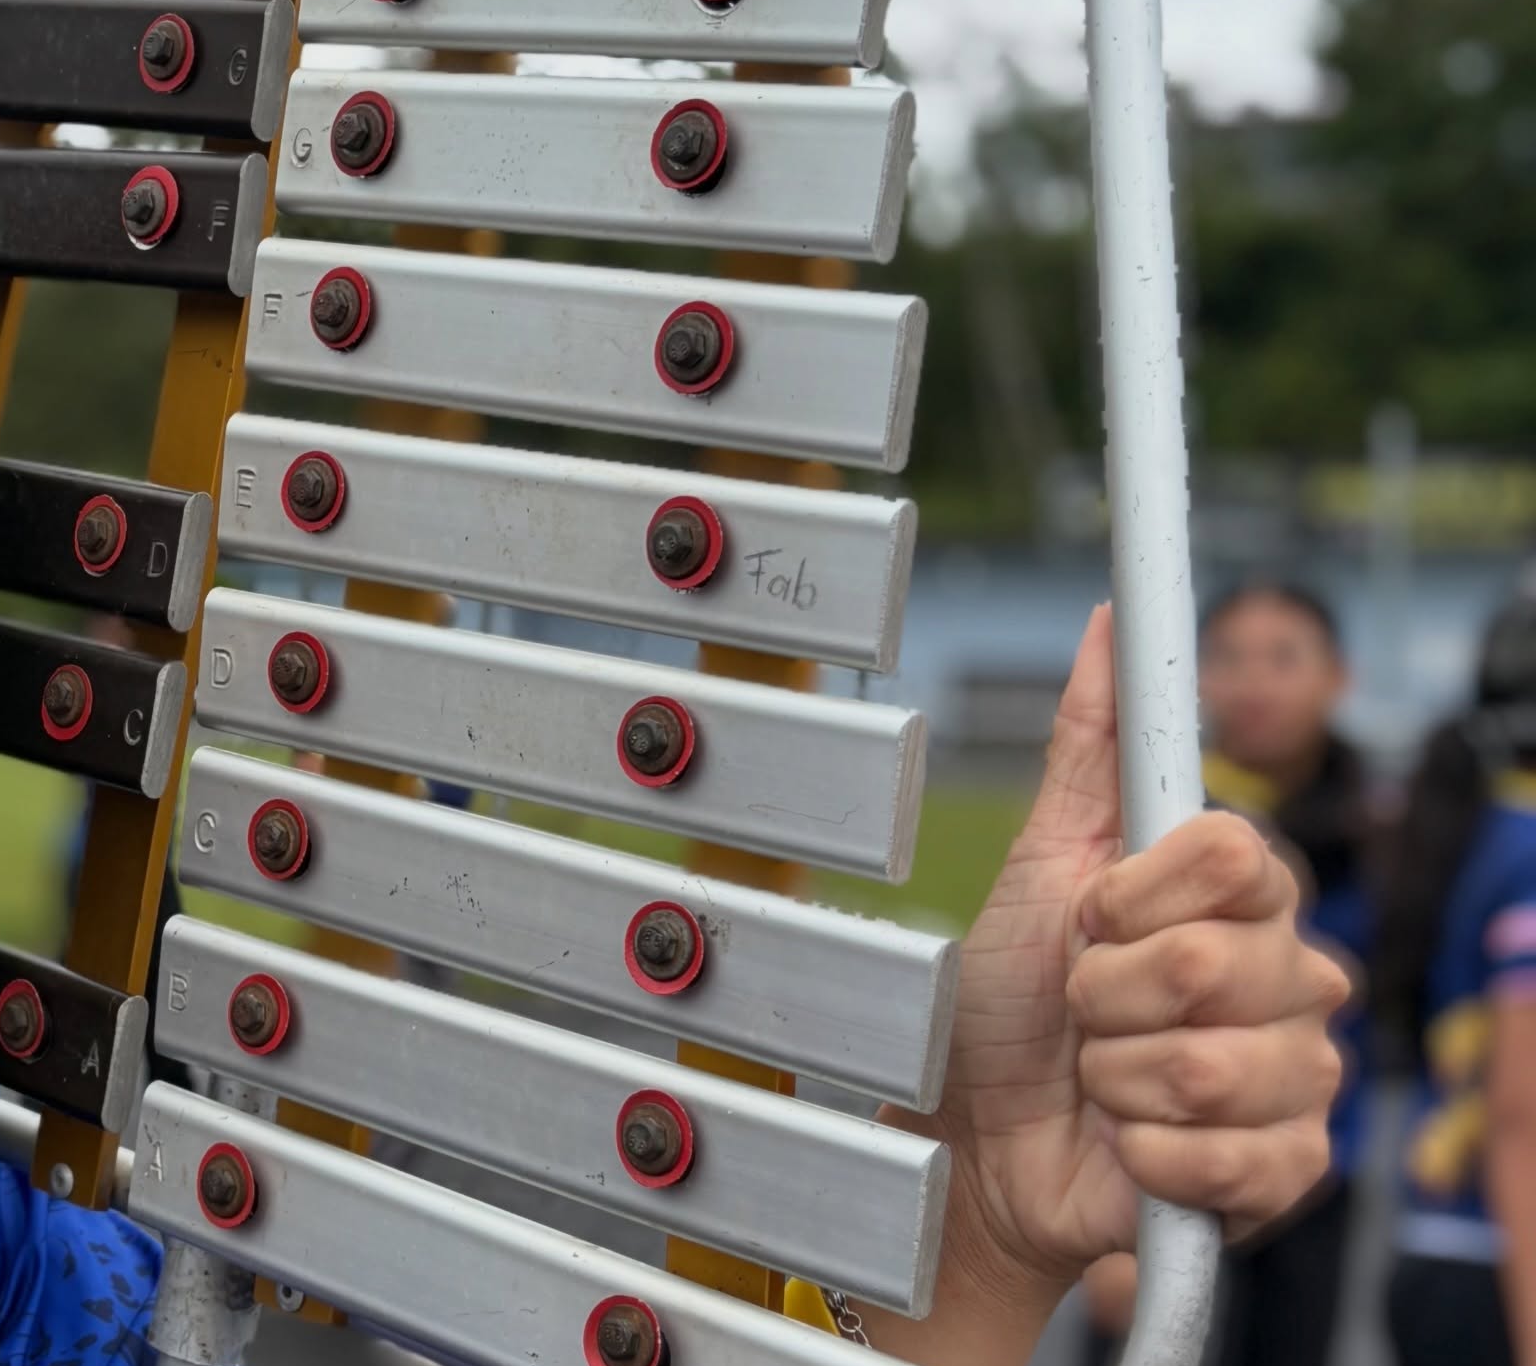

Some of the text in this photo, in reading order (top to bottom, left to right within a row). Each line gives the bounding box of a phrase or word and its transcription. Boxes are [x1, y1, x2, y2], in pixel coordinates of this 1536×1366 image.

[229, 48, 248, 85] G
[291, 127, 312, 168] G
[208, 201, 230, 242] F
[261, 293, 283, 333] F
[235, 468, 256, 509] E
[147, 541, 168, 577] D
[743, 547, 817, 611] Fab
[211, 648, 233, 689] D
[124, 709, 144, 745] C
[194, 811, 216, 854] C
[168, 972, 187, 1012] B
[81, 1038, 100, 1078] A
[144, 1140, 165, 1184] A
